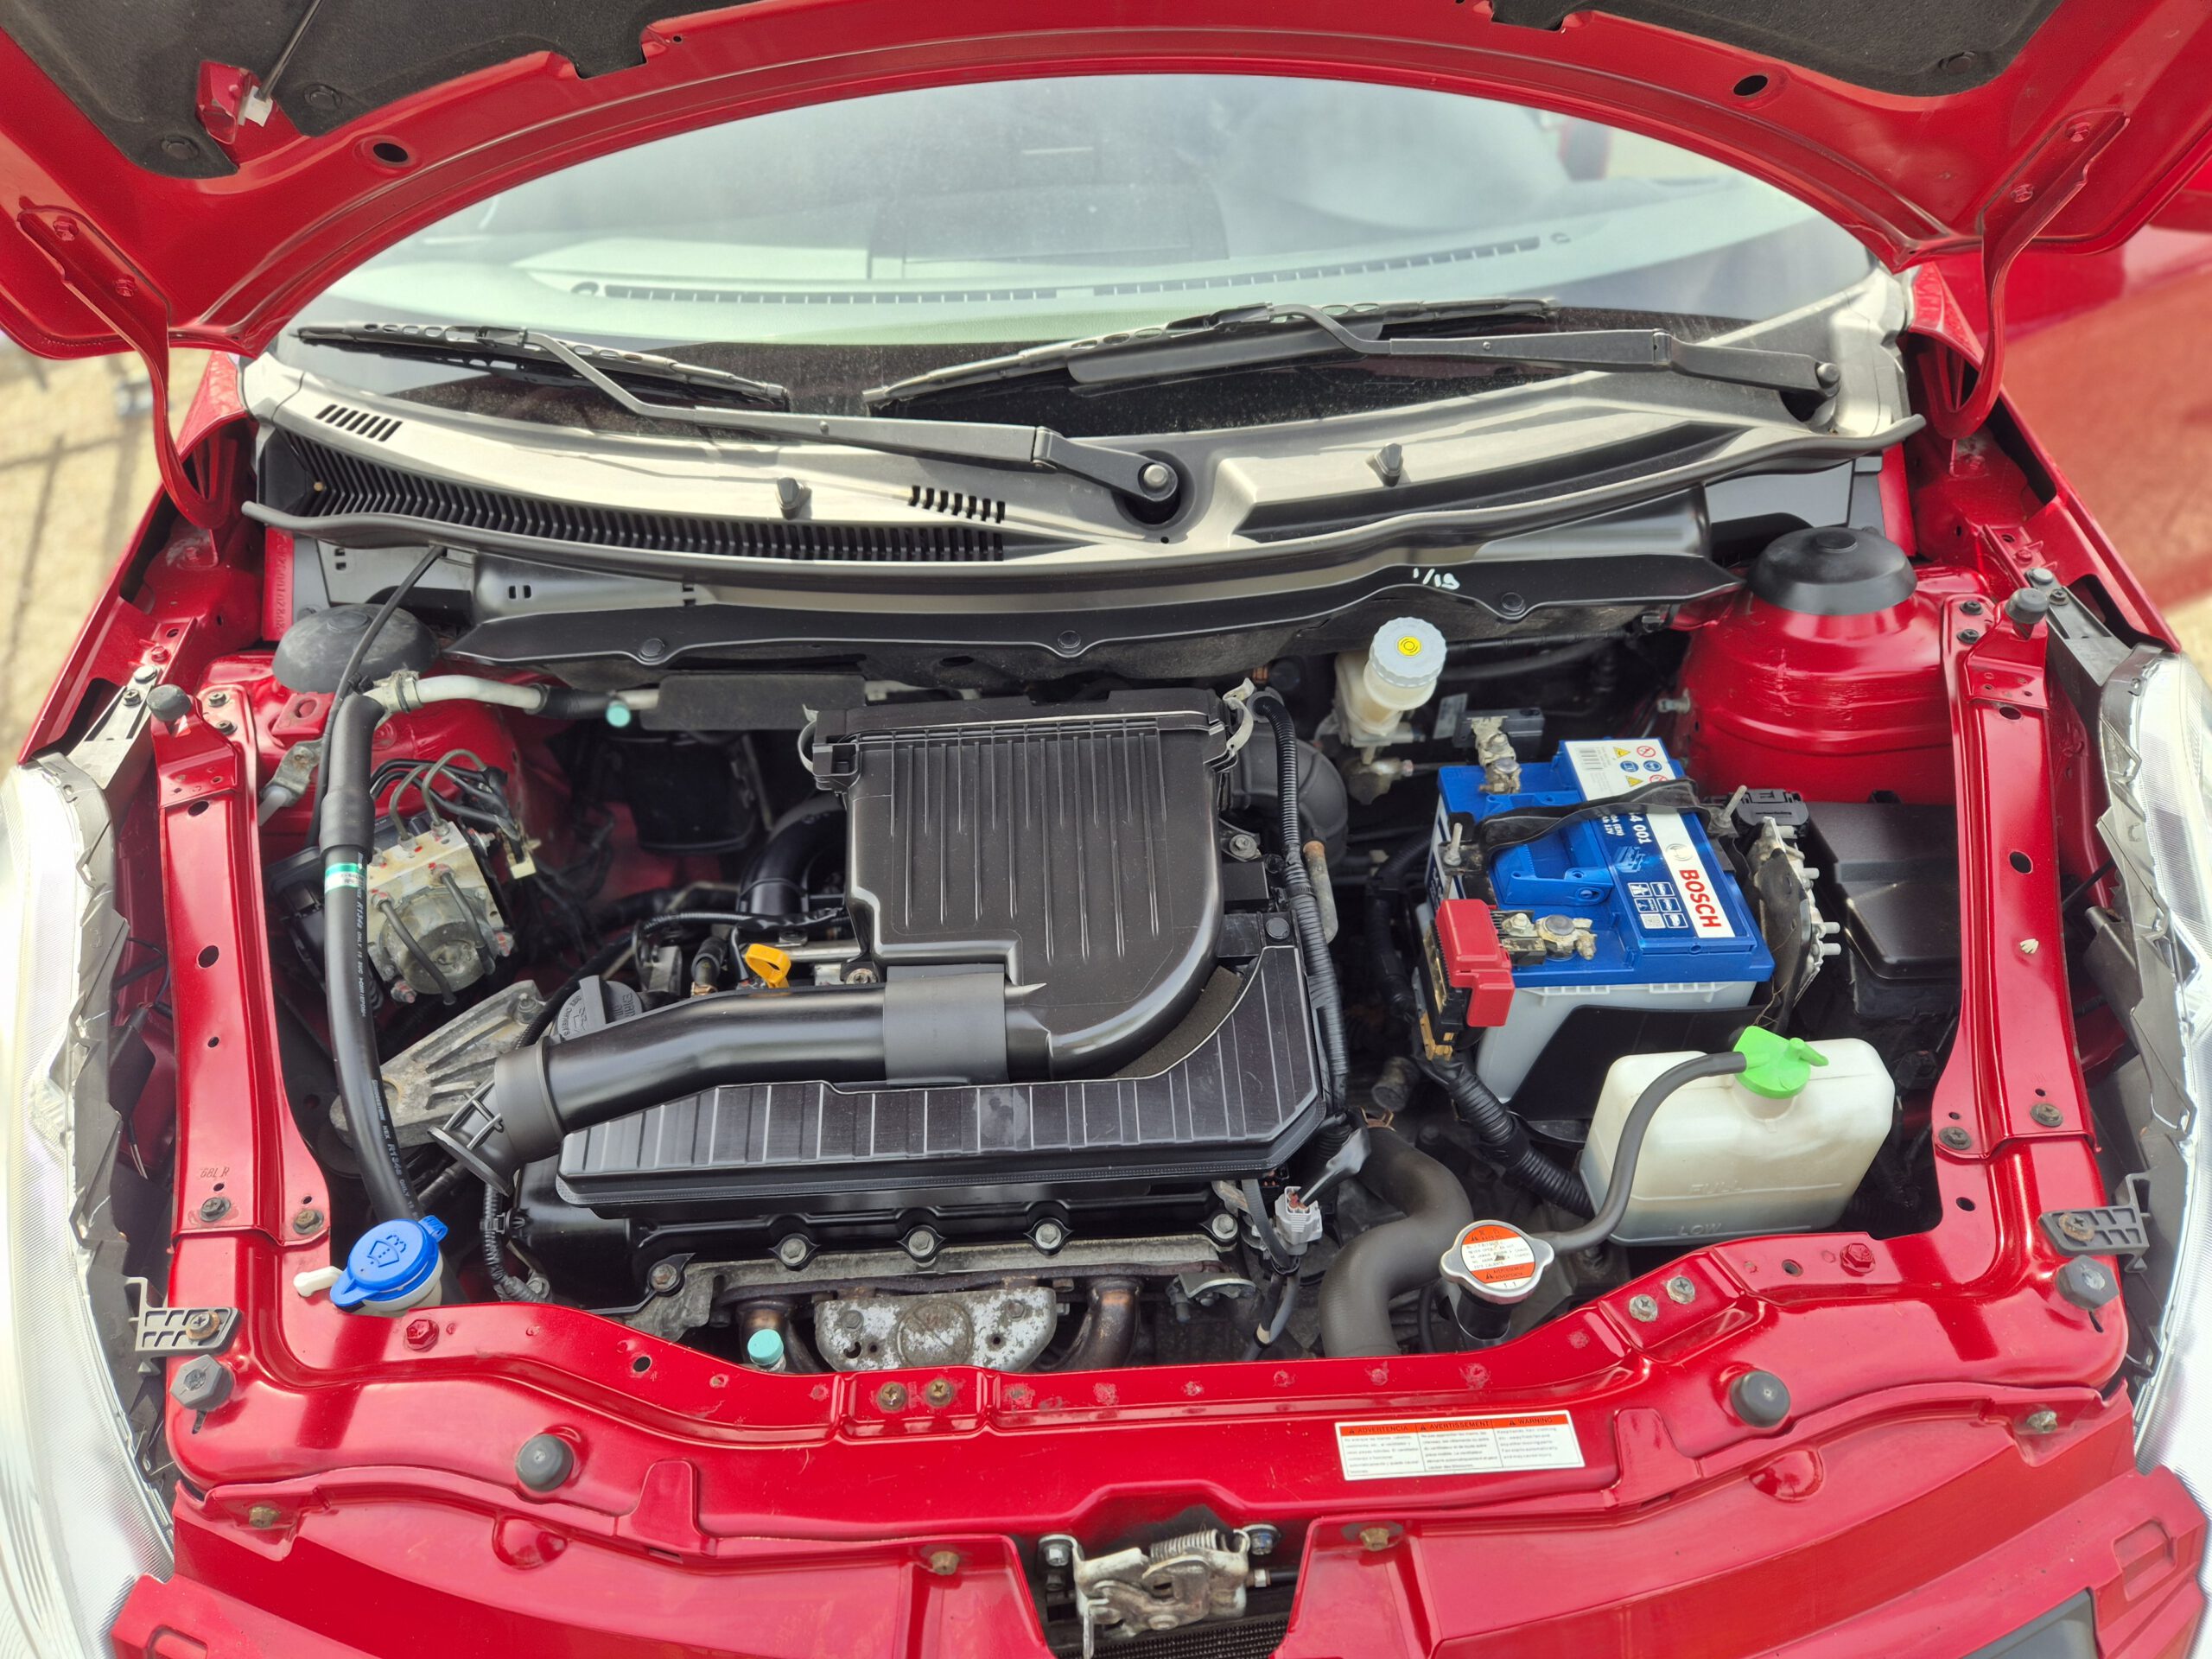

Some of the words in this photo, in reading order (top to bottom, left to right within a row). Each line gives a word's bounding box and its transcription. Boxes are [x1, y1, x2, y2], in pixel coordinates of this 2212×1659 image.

[1632, 824, 1652, 844] 001
[1679, 869, 1722, 928] BOSCH
[1689, 1180, 1743, 1197] FULL
[1678, 1222, 1722, 1236] LOW
[1430, 1421, 1490, 1430] AVERTISSEMENT
[1517, 1416, 1553, 1425] WARNING
[1357, 1426, 1408, 1434] ADVERTENCIA
